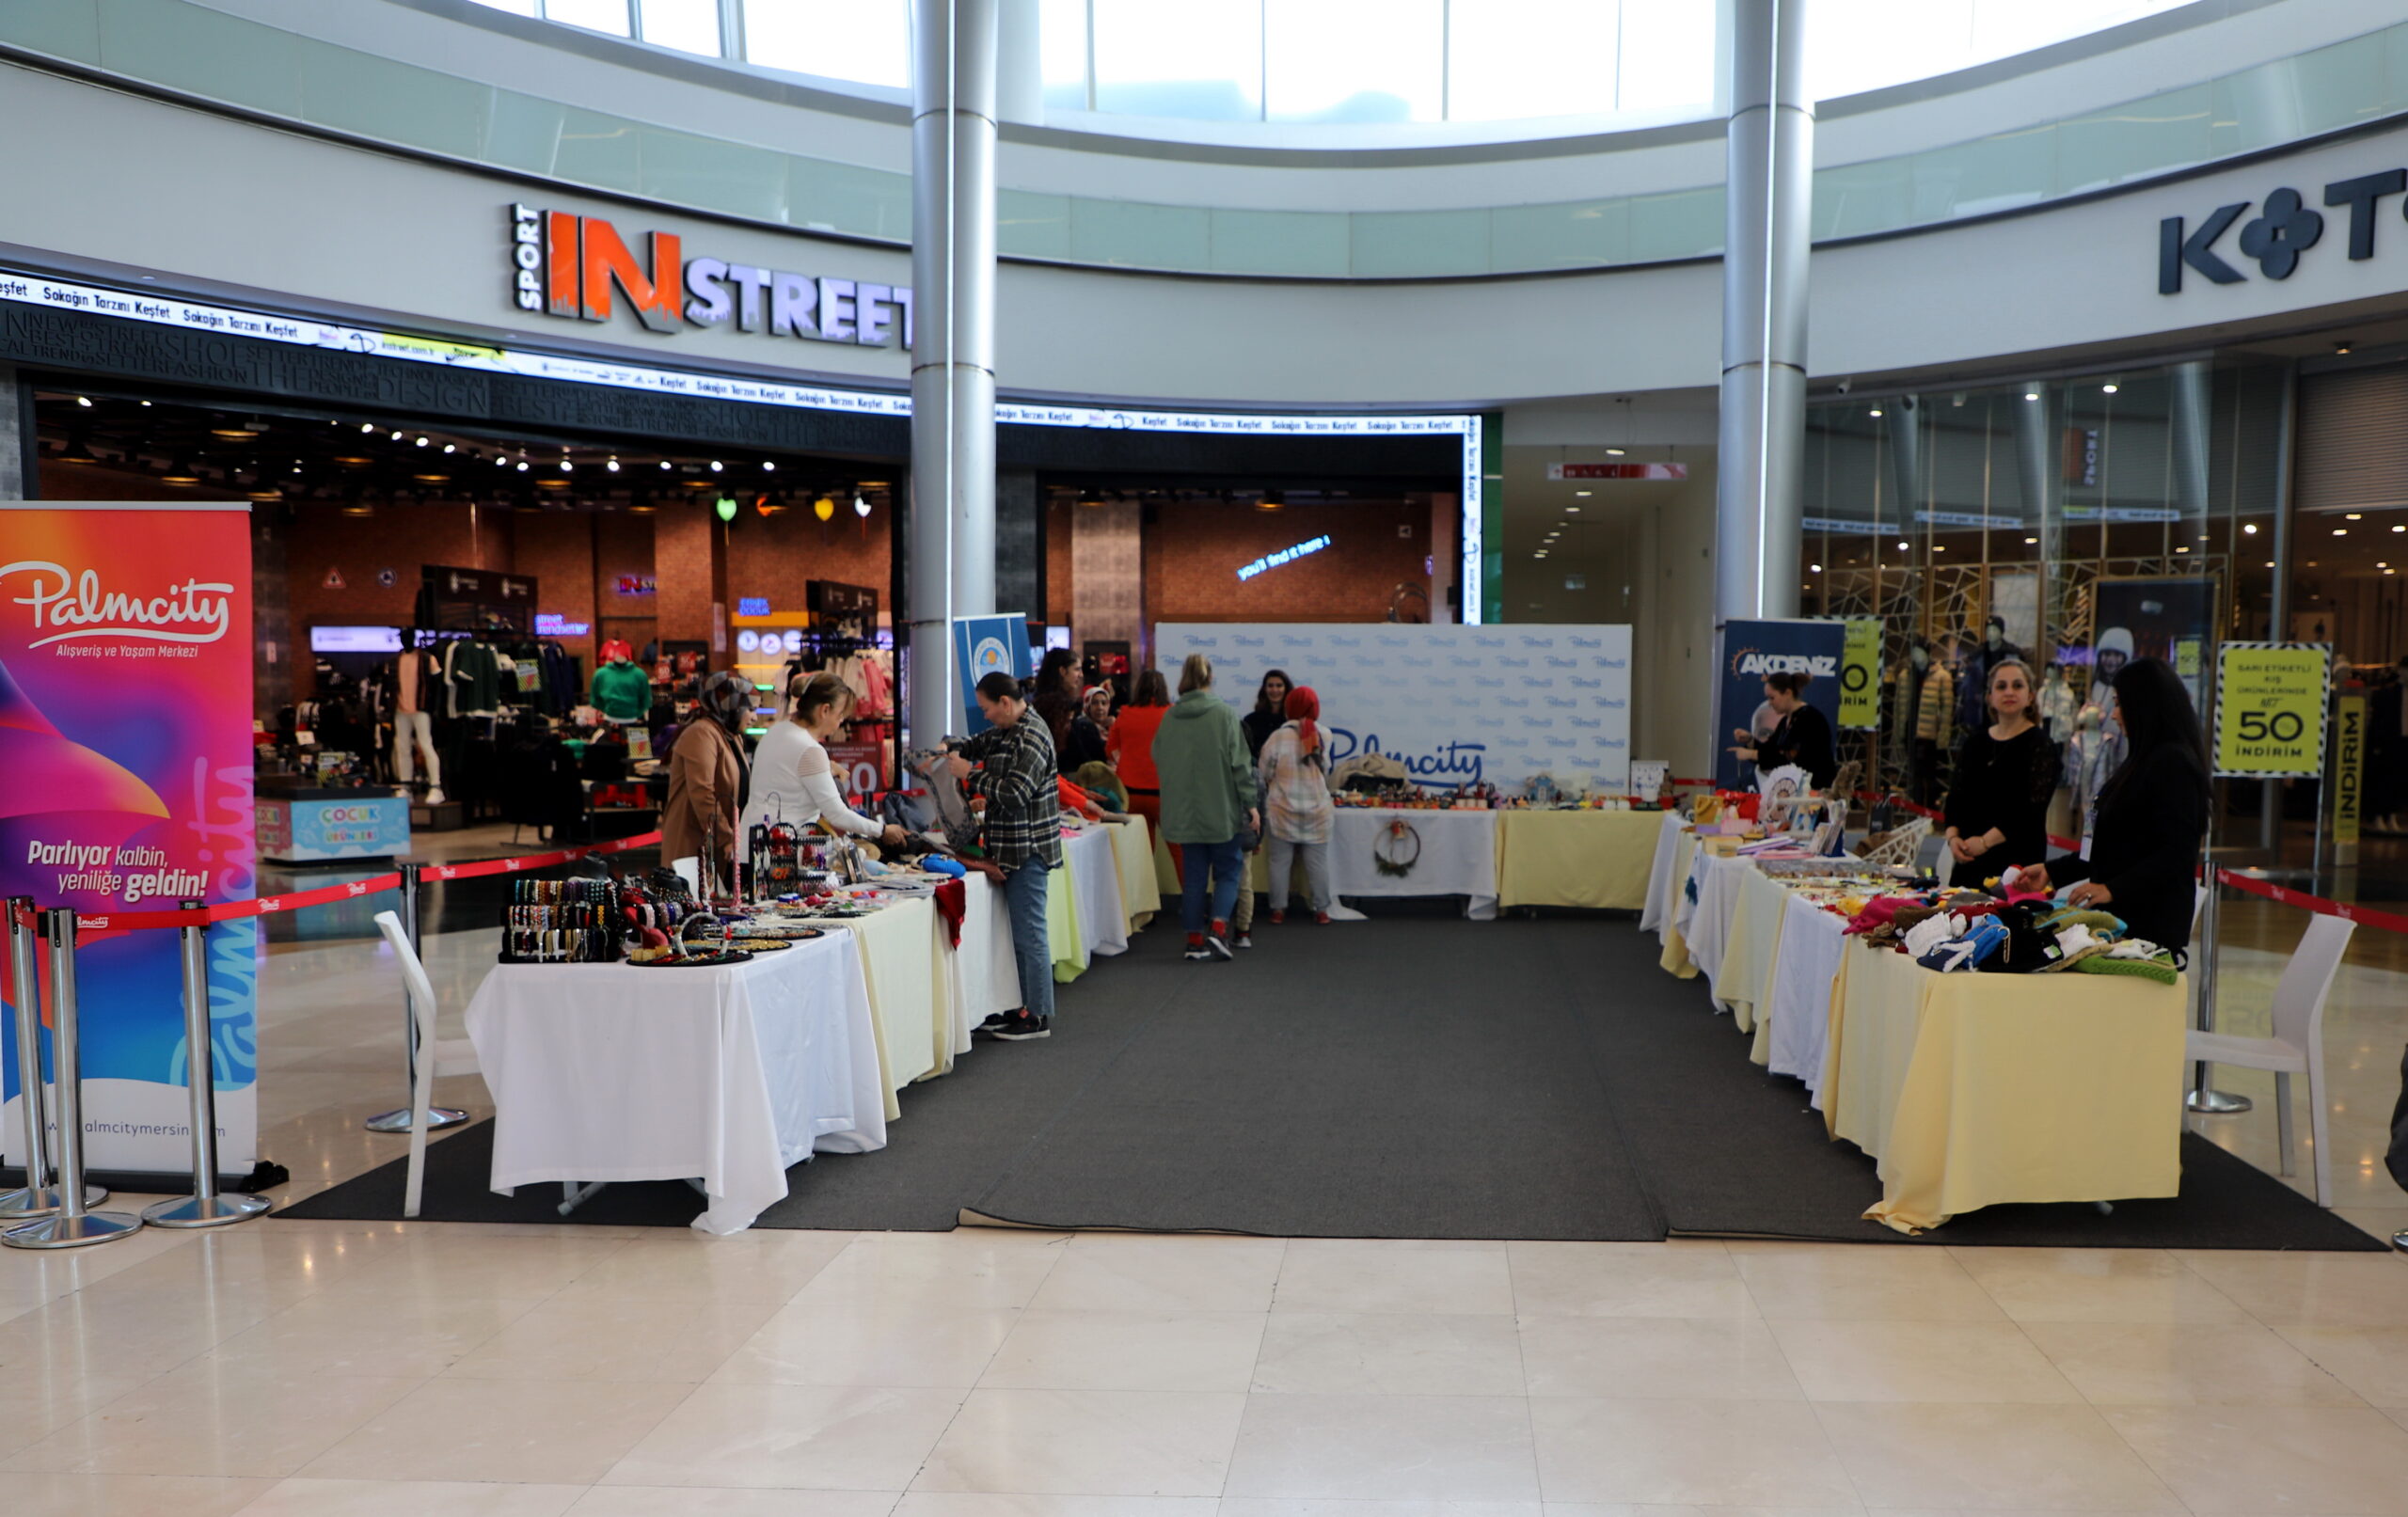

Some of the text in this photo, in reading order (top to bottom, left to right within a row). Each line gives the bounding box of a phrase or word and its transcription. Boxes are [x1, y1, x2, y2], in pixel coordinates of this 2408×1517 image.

[512, 202, 542, 311] SPORT
[0, 281, 27, 297] eşfet
[135, 301, 170, 320] Keşfet
[265, 322, 299, 340] Keşfet
[0, 561, 234, 649] Palmcity
[56, 644, 198, 658] Alışveriş ve Yaşam Merkezi
[1740, 654, 1836, 676] AKDENİZ
[2238, 711, 2304, 742] 50
[1330, 727, 1486, 788] Plmcity
[2236, 745, 2303, 758] İNDİRİM
[27, 840, 169, 871] Parlıyor kalbin,
[57, 868, 209, 903] yeniliğe geldin!
[76, 916, 109, 928] lmcity
